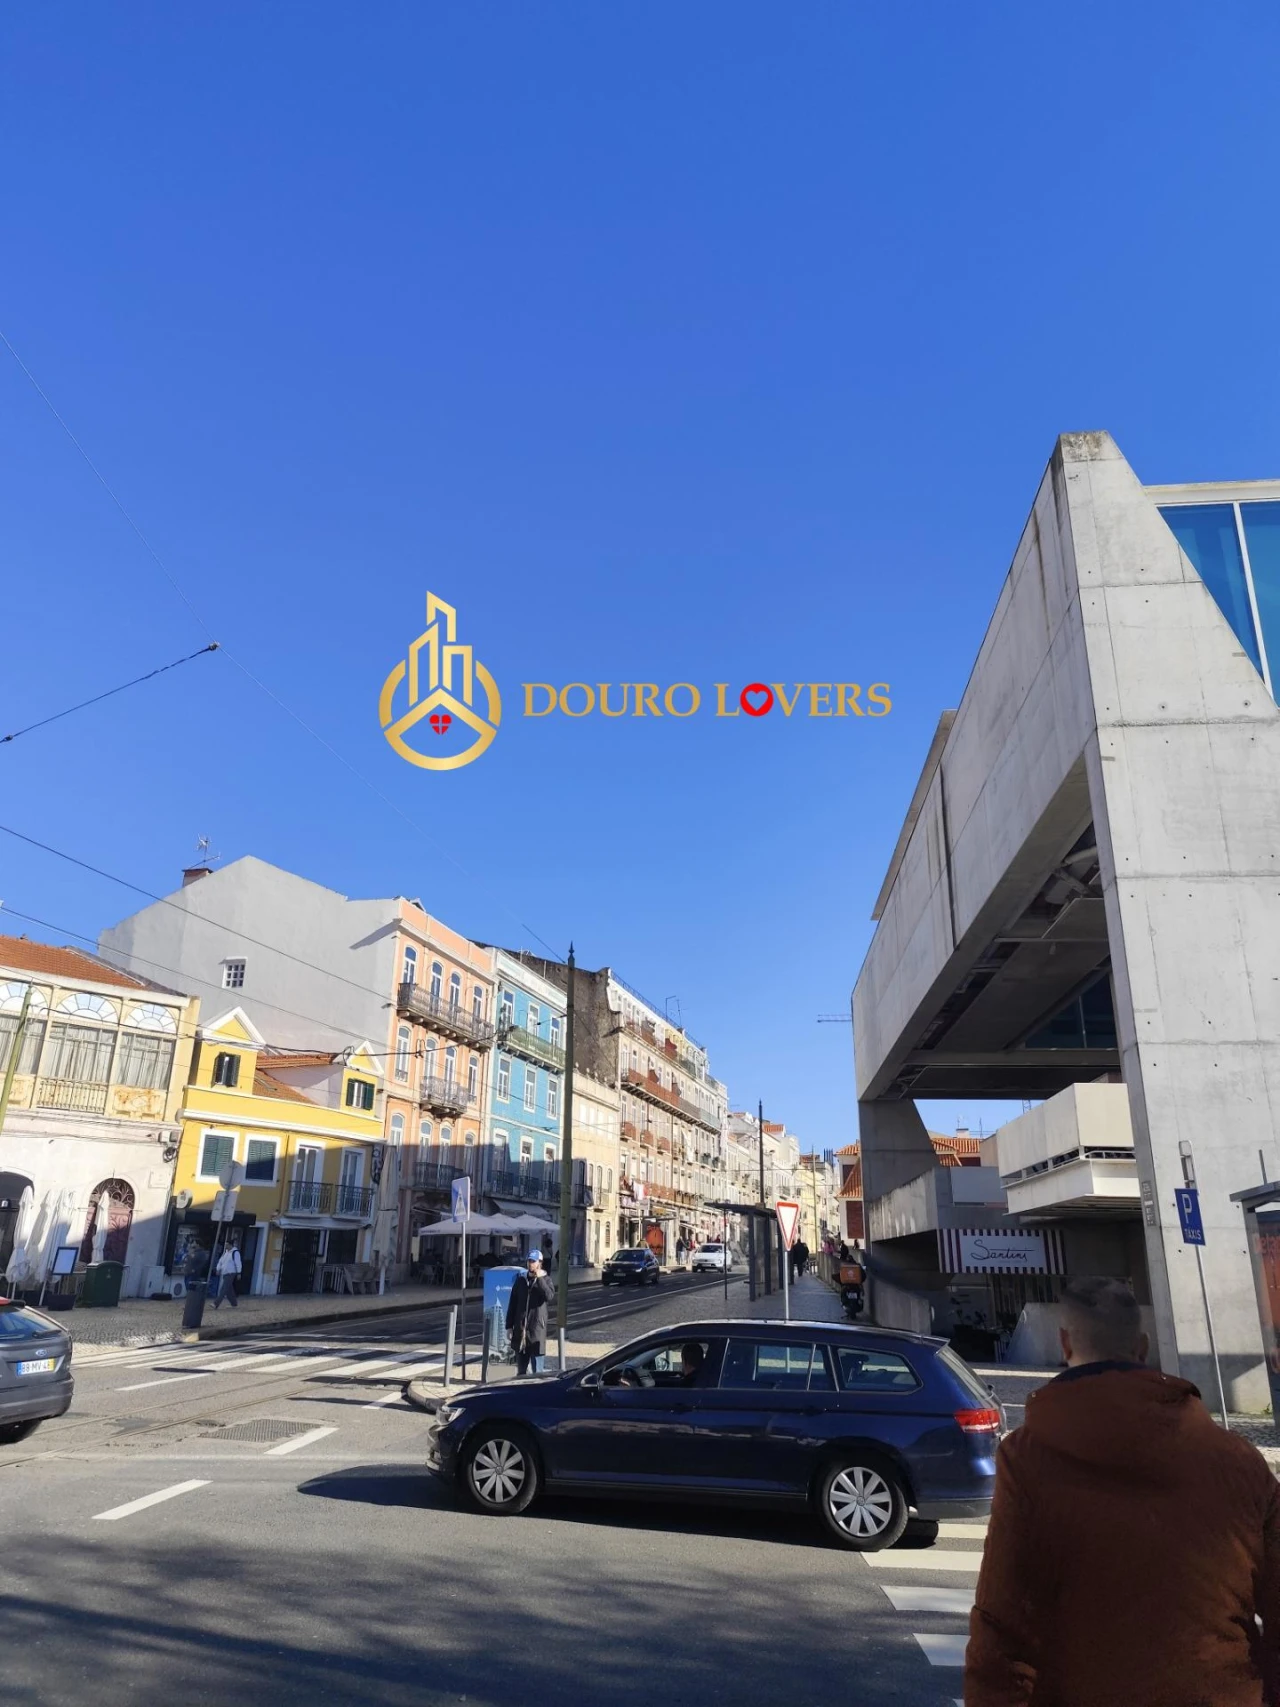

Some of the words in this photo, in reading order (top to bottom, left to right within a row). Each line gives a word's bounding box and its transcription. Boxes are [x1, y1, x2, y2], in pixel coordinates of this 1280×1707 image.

[1181, 1193, 1193, 1224] P
[1184, 1228, 1202, 1240] TAXIS
[970, 1239, 1035, 1262] Santini
